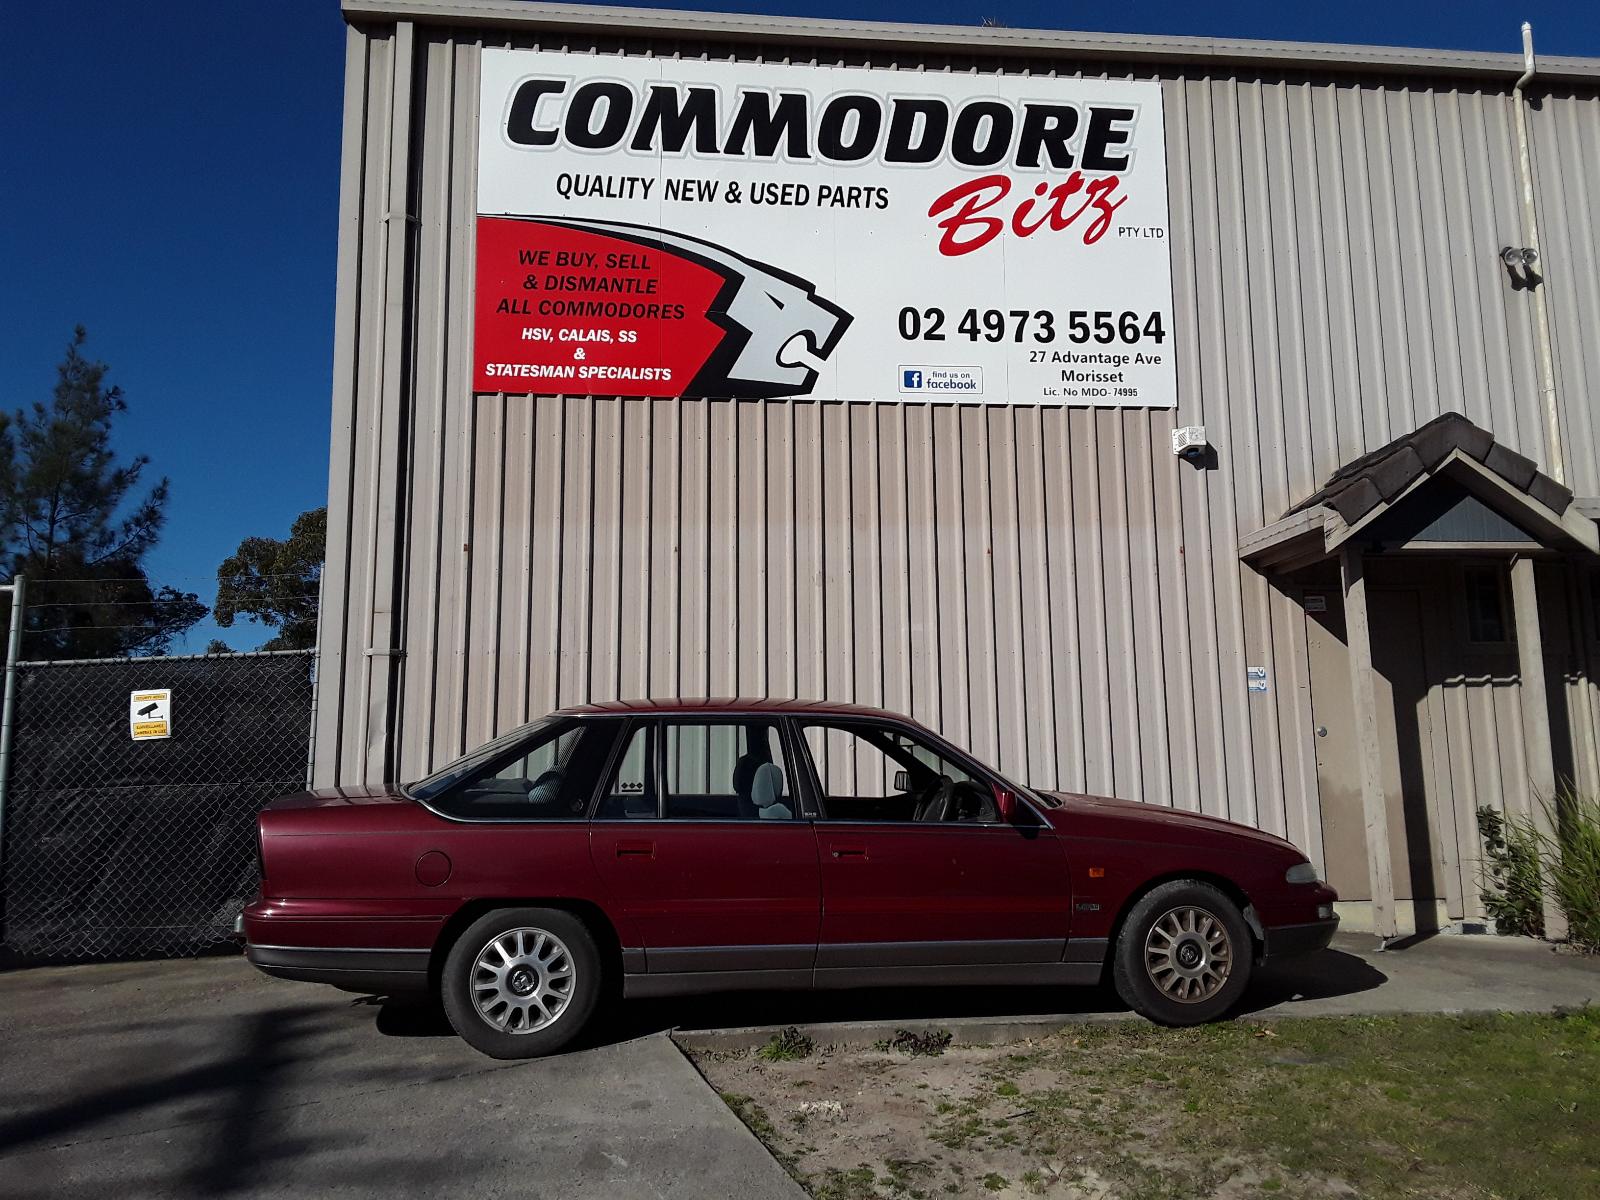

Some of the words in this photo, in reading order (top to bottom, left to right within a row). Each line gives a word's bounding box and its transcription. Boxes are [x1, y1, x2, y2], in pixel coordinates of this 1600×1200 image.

[504, 77, 1136, 173] COMMODORE
[556, 172, 656, 201] QUALITY
[664, 178, 720, 203] NEW
[724, 180, 743, 204] &
[749, 182, 810, 207] USED
[816, 184, 889, 210] PARTS
[927, 170, 1128, 257] Bitz
[1118, 226, 1140, 238] PTY
[1143, 227, 1164, 239] LTD
[518, 249, 551, 267] WE
[555, 251, 599, 270] BUY,
[605, 252, 651, 271] SELL
[522, 274, 539, 291] &
[543, 274, 659, 295] DISMANTLE
[495, 298, 532, 315] ALL
[538, 299, 685, 320] COMMODORES
[898, 306, 946, 342] 02
[957, 308, 1056, 344] 4973
[1068, 310, 1166, 345] 5564
[521, 327, 554, 343] HSV,
[558, 328, 614, 345] CALAIS,
[617, 329, 638, 344] SS
[573, 347, 586, 361] &
[1029, 350, 1047, 363] 27
[1051, 350, 1130, 368] Advantage
[1134, 352, 1162, 365] Ave
[485, 363, 576, 379] STATESMAN
[577, 365, 672, 381] SPECIALISTS
[932, 370, 947, 379] find
[1061, 369, 1124, 383] Morisset
[926, 377, 977, 390] facebook
[1043, 387, 1060, 397] Lic.
[1063, 387, 1079, 397] No
